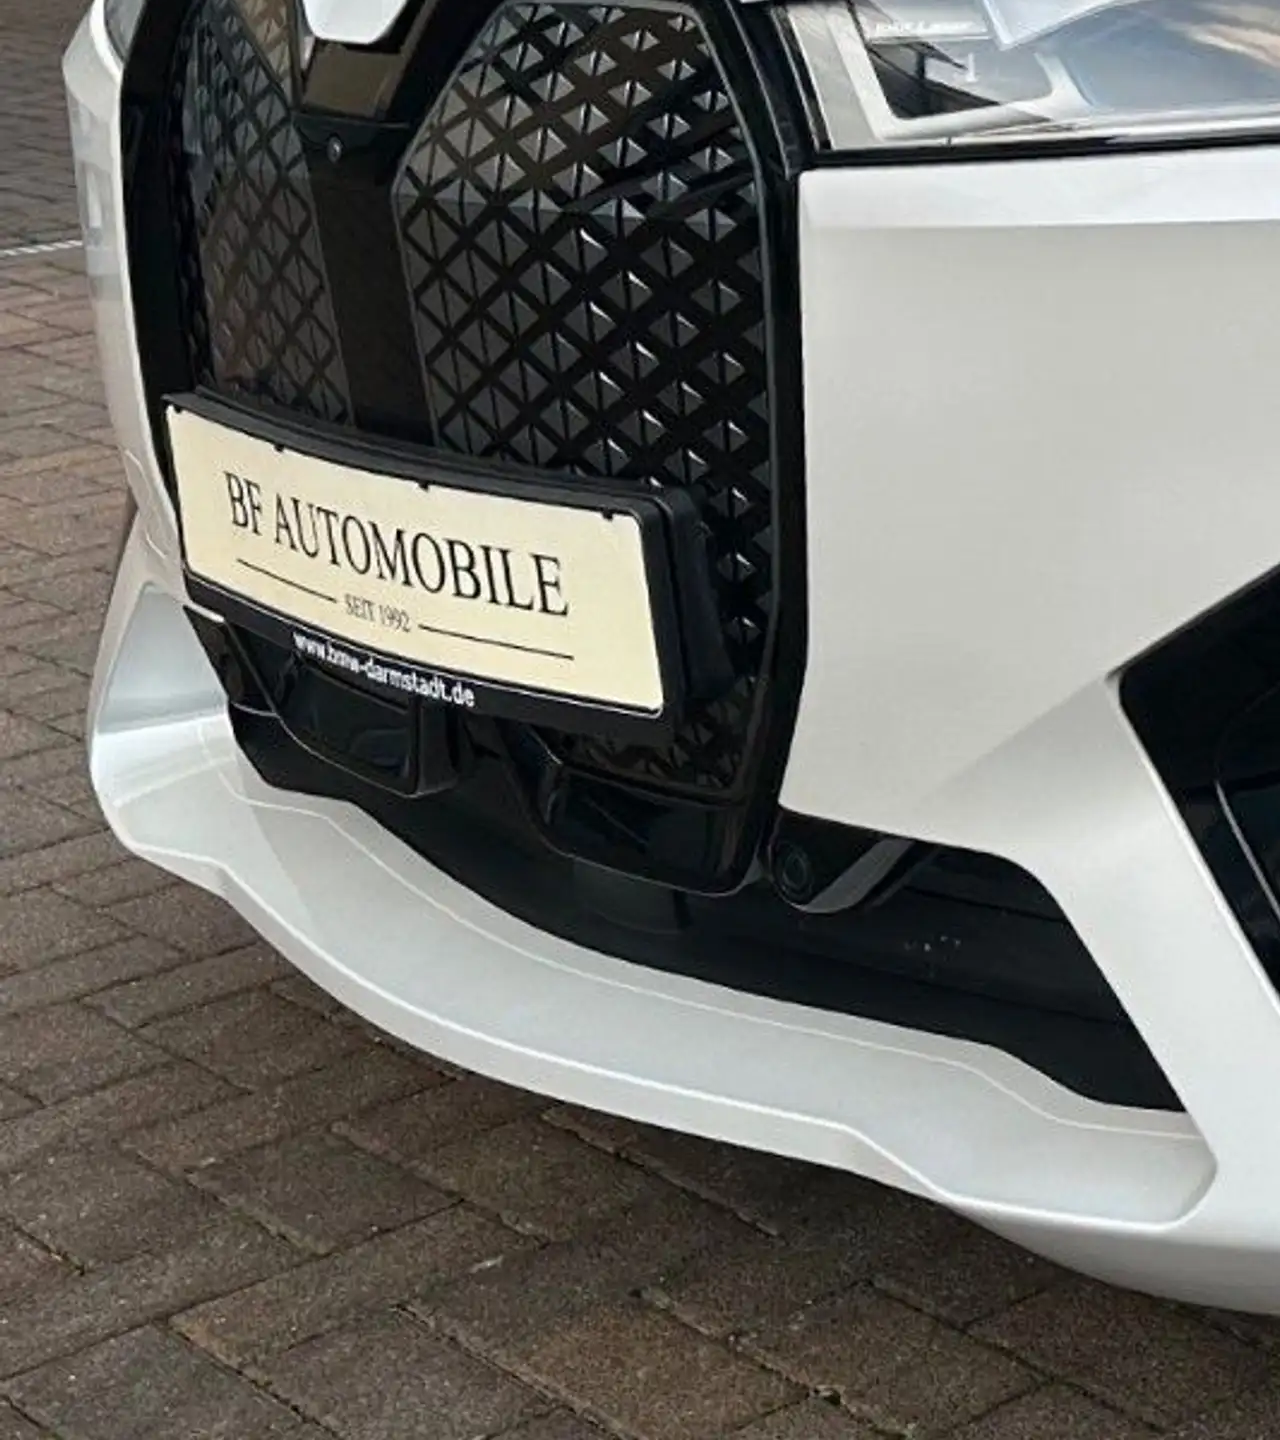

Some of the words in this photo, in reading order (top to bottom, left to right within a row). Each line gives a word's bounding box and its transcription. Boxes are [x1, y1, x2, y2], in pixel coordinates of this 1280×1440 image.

[225, 471, 262, 536] BF
[275, 492, 570, 617] AUTOMOBILE
[344, 593, 376, 622] SEIT
[378, 604, 411, 633] 1992
